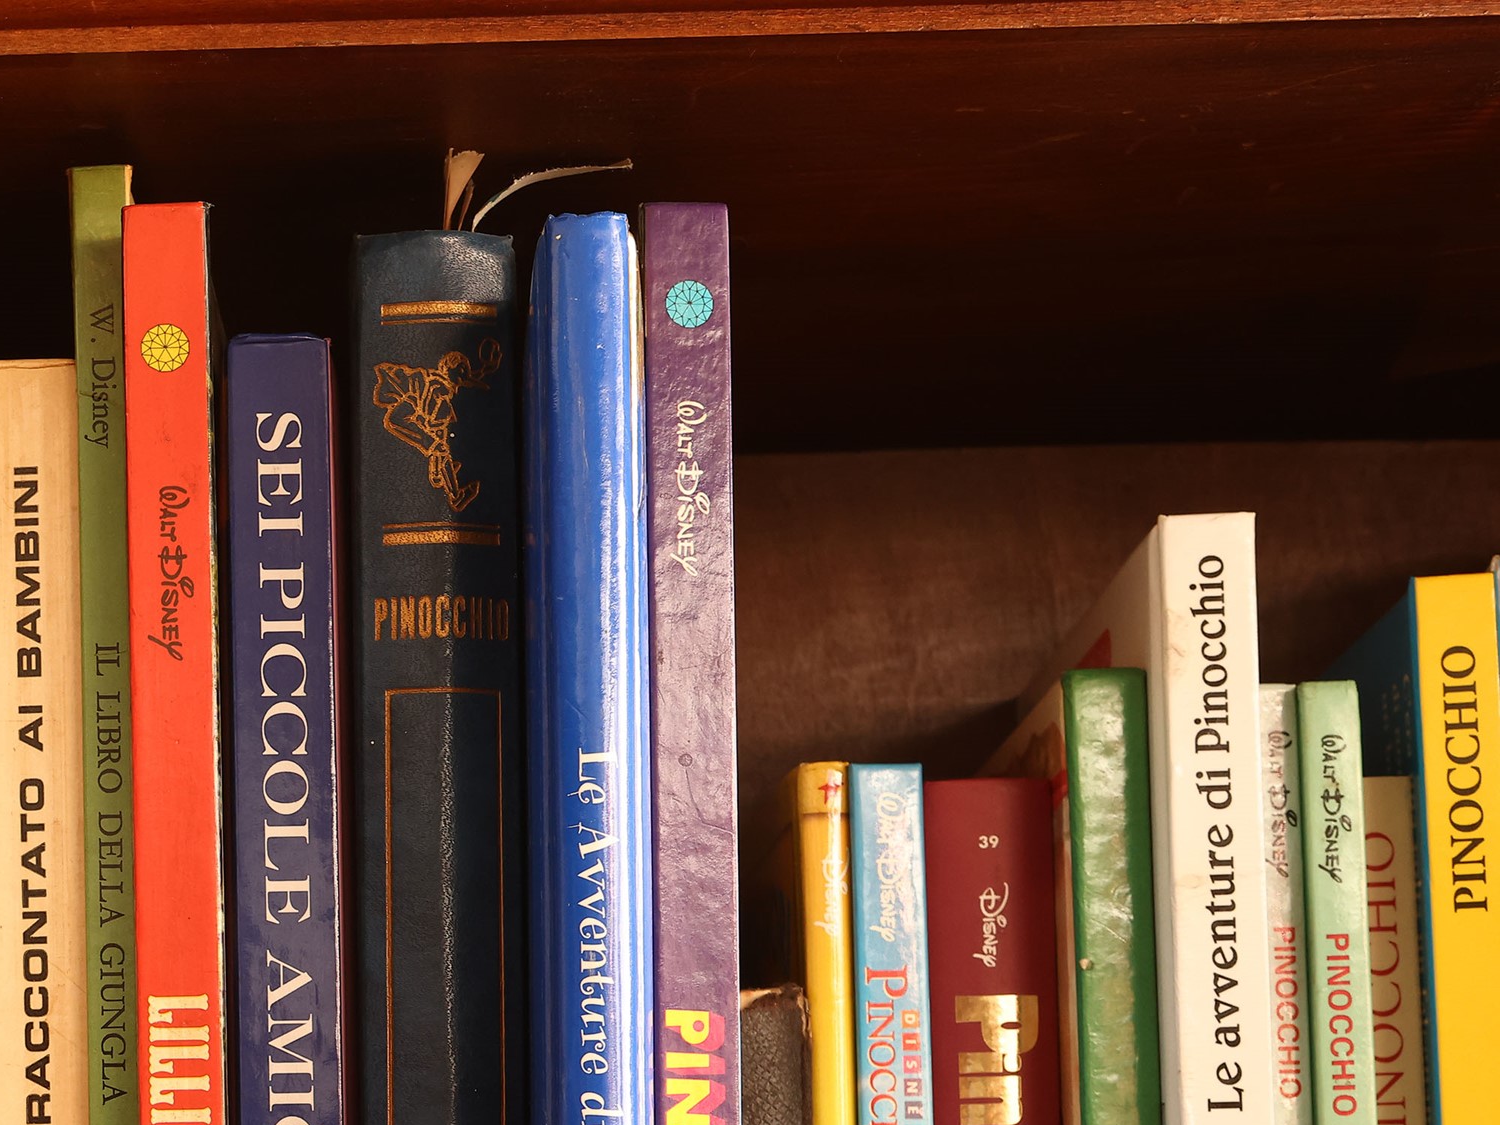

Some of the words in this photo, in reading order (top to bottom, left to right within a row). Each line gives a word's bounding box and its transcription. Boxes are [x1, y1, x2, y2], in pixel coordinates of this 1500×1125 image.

[89, 303, 115, 343] W.
[84, 355, 116, 449] Disney
[255, 411, 304, 536] SEI
[13, 466, 44, 677] BAMBINI
[375, 597, 510, 642] PINOCCHIO
[95, 642, 120, 676] IL
[1190, 554, 1230, 753] Pinocchio
[18, 703, 44, 752] AI
[96, 691, 123, 794] LIBRO
[258, 561, 311, 925] PICCOLE
[567, 748, 618, 804] Le
[1194, 767, 1231, 809] di
[1441, 645, 1488, 913] PINOCCHIO
[98, 811, 125, 928] DELLA
[978, 836, 999, 849] 39
[19, 777, 51, 1125] RACCONTATO
[567, 822, 619, 1075] Avventure
[1204, 824, 1242, 1047] avventure
[100, 942, 128, 1106] GIUNGLA
[147, 993, 211, 1125] LILLI
[1273, 926, 1302, 1099] PINOCCHIO
[1325, 933, 1358, 1116] PINOCCHIO
[1207, 1061, 1244, 1112] Le
